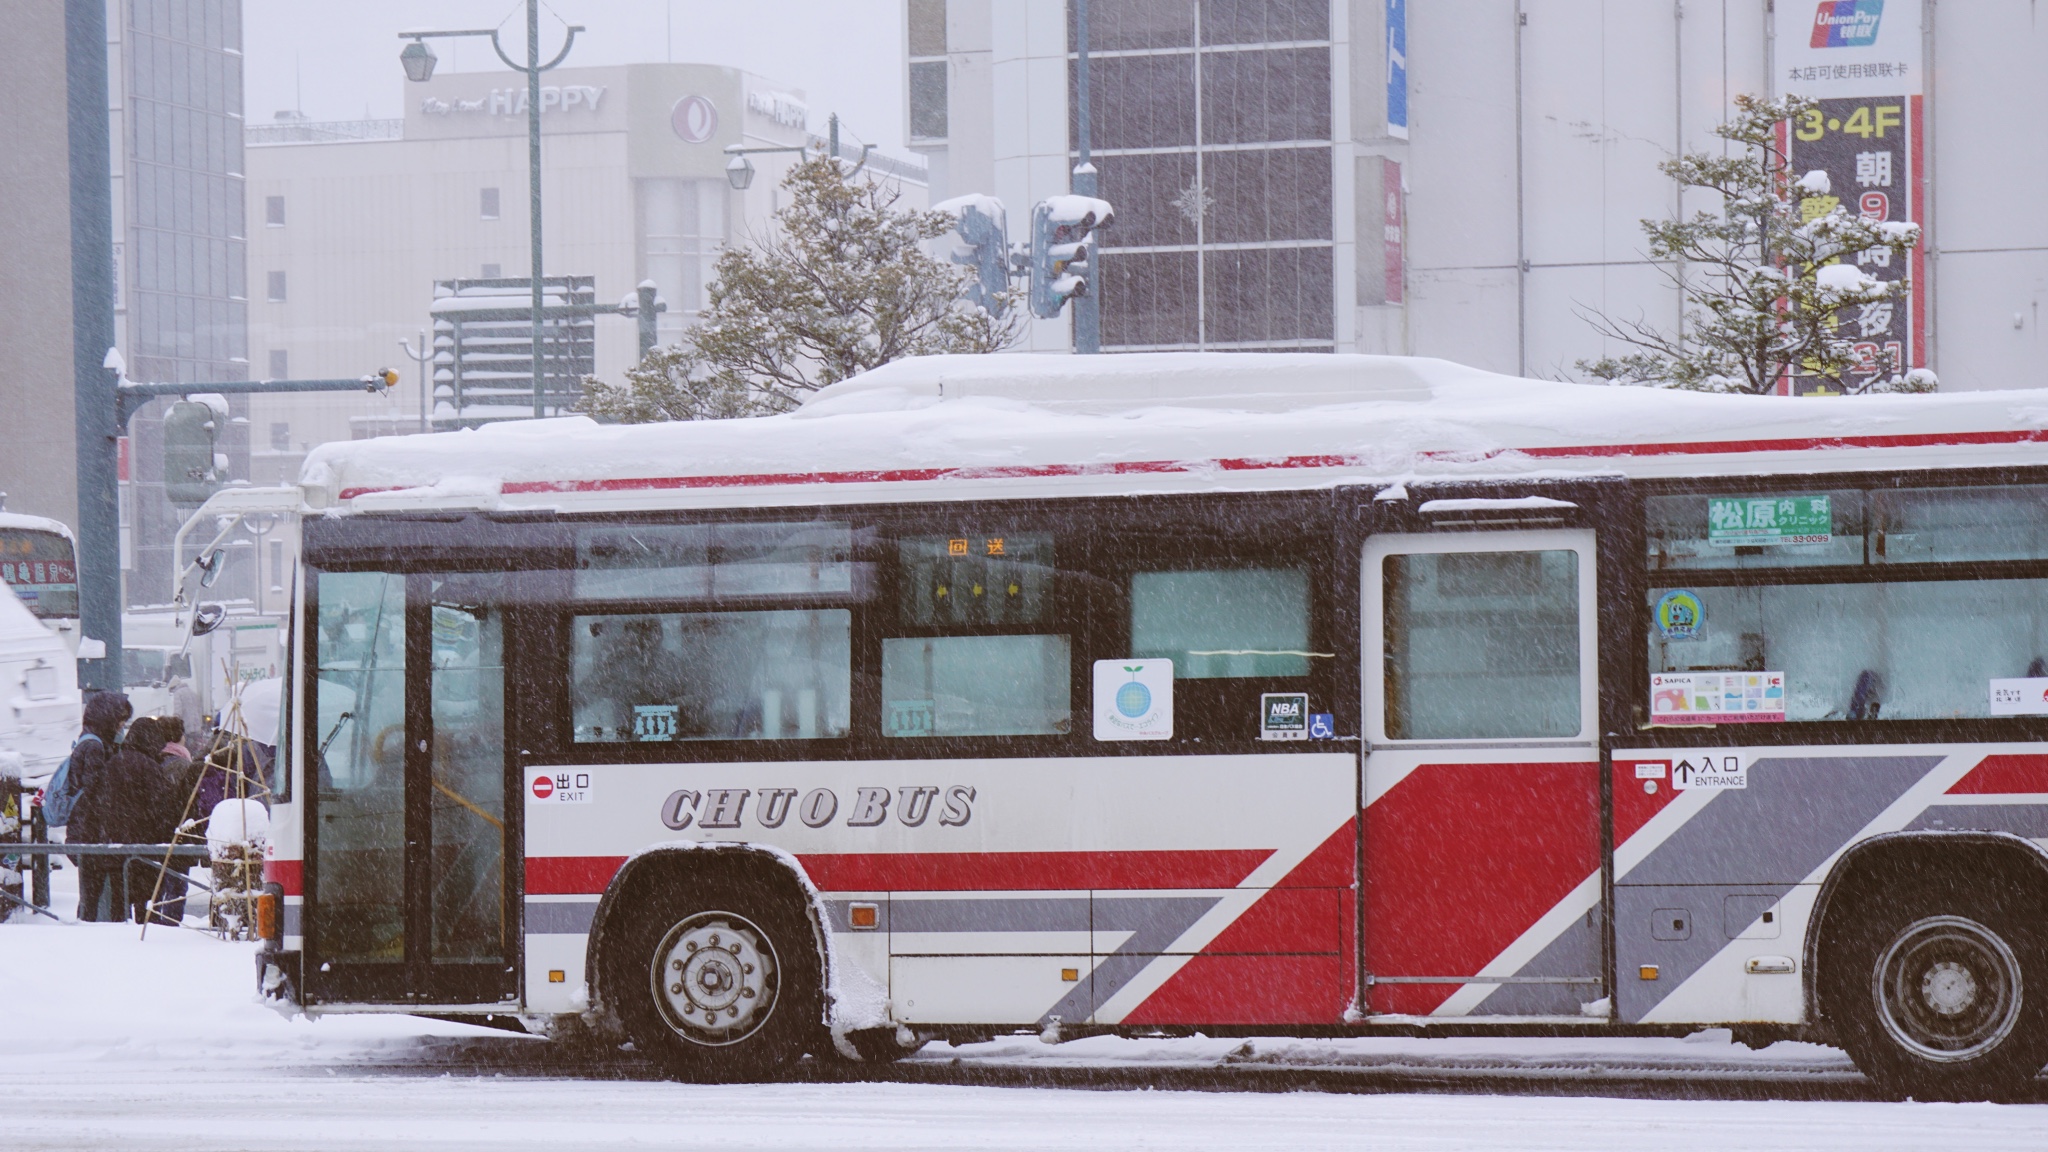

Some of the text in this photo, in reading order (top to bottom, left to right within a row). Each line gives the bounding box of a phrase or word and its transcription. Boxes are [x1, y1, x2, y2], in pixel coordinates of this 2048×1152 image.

[1817, 11, 1879, 25] UnionPay
[1788, 62, 1908, 81] 本店可使用银联卡
[489, 85, 608, 116] HAPPY
[1712, 501, 1777, 529] 松原
[1779, 515, 1828, 526] クリニック
[948, 538, 1005, 556] 回送
[1271, 703, 1299, 715] NBA
[1701, 756, 1738, 773] 入口
[556, 773, 589, 789] 出口
[1695, 776, 1745, 787] ENTRANCE
[560, 792, 585, 801] EXIT
[660, 784, 977, 831] CHUO BUS
